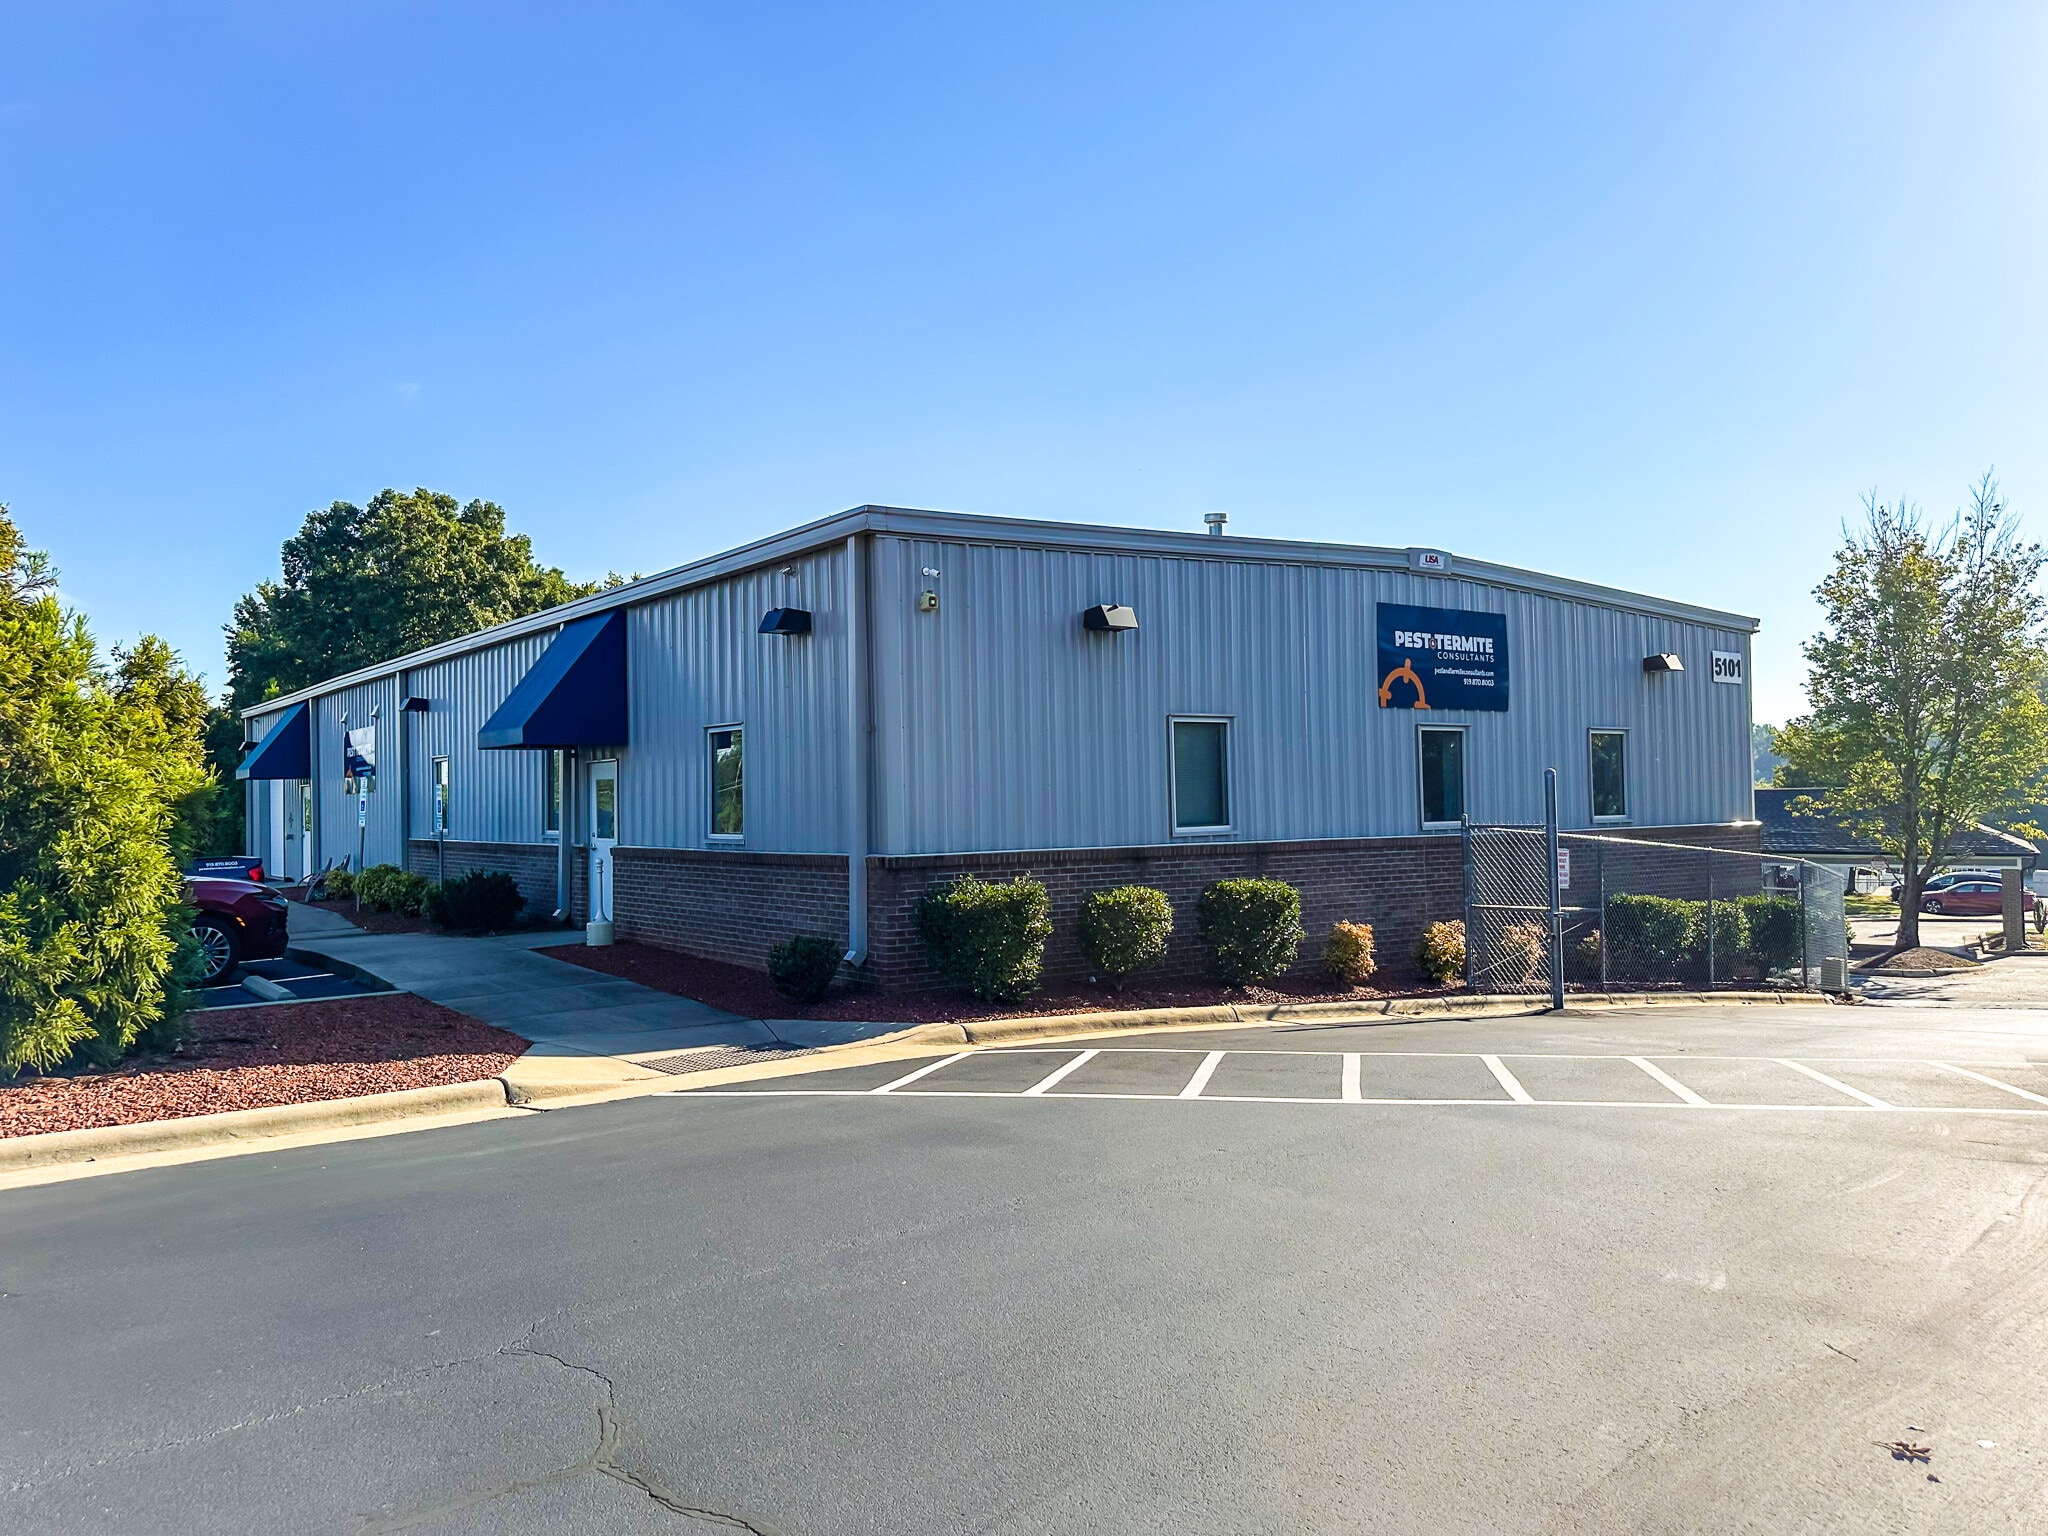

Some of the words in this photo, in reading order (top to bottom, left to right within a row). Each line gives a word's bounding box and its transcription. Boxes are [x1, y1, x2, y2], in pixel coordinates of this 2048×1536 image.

[1425, 554, 1438, 564] USA
[1394, 630, 1431, 649] PEST
[1434, 633, 1494, 653] TERMITE
[1437, 651, 1494, 662] CONSULTANTS
[1714, 657, 1742, 678] 5101
